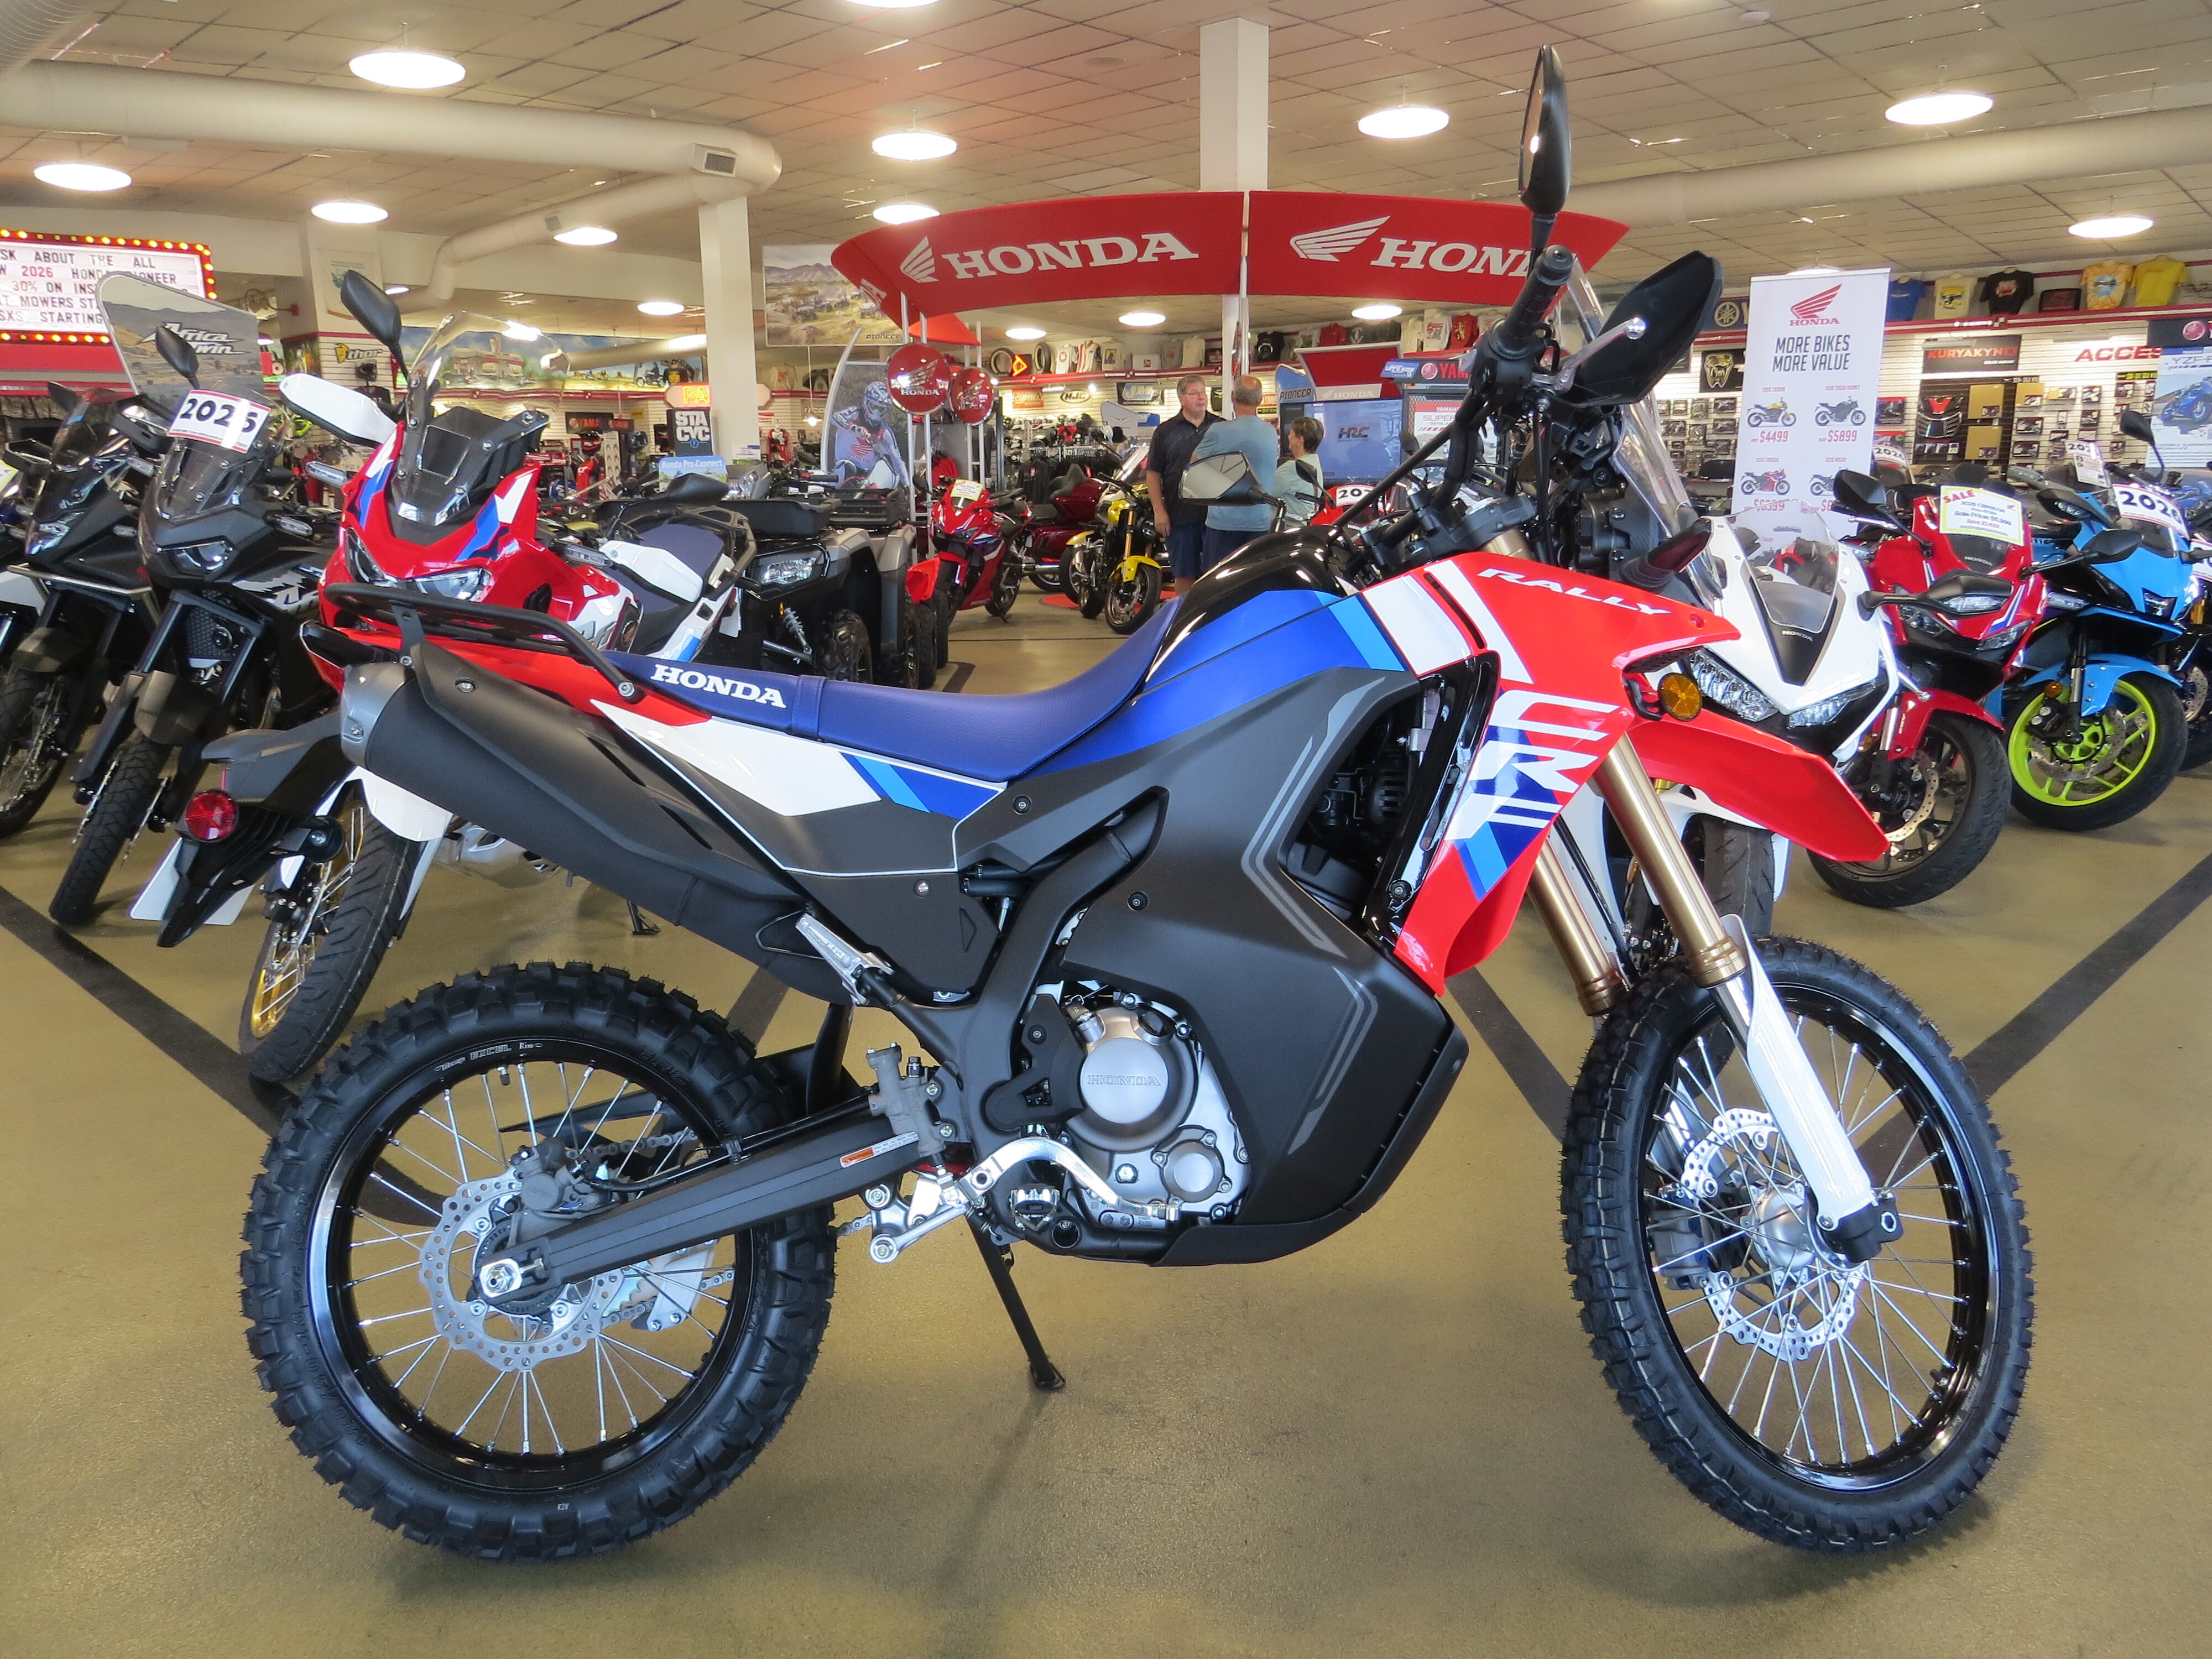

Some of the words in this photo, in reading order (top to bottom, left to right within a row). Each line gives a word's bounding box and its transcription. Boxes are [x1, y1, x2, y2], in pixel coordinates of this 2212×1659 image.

[0, 249, 17, 261] SK
[34, 251, 75, 264] ABOUT
[89, 254, 114, 267] THE
[133, 257, 156, 269] ALL
[942, 232, 1199, 279] HONDA
[1370, 238, 1532, 277] HON
[22, 265, 54, 278] 2026
[71, 268, 109, 280] HOND
[12, 280, 38, 292] 30%
[46, 281, 62, 293] ON
[74, 283, 96, 294] INS
[19, 295, 74, 308] MOWERS
[40, 311, 104, 324] STARTING
[1788, 318, 1840, 326] HONDA
[1775, 336, 1811, 354] MORE
[1813, 335, 1851, 353] BIKES
[1927, 347, 2003, 359] KURYAKYN
[1772, 354, 1808, 373] MORE
[1811, 353, 1851, 371] VALUE
[1280, 388, 1311, 400] PIONEER
[1333, 390, 1374, 399] HONDA
[675, 411, 708, 426] STA
[676, 426, 710, 442] CYC
[1338, 427, 1370, 439] HRC
[1759, 430, 1789, 443] $4499
[1827, 430, 1858, 442] $5899
[662, 460, 682, 468] Honda
[683, 460, 723, 468] Pro-Connect
[1338, 488, 1371, 499] 20
[1943, 489, 1976, 504] SALE
[1477, 568, 1672, 615] RALLY
[1781, 630, 1813, 641] HONDA
[650, 664, 787, 709] HONDA
[469, 1044, 512, 1060] EXCEL
[1087, 1074, 1161, 1086] HONDA
